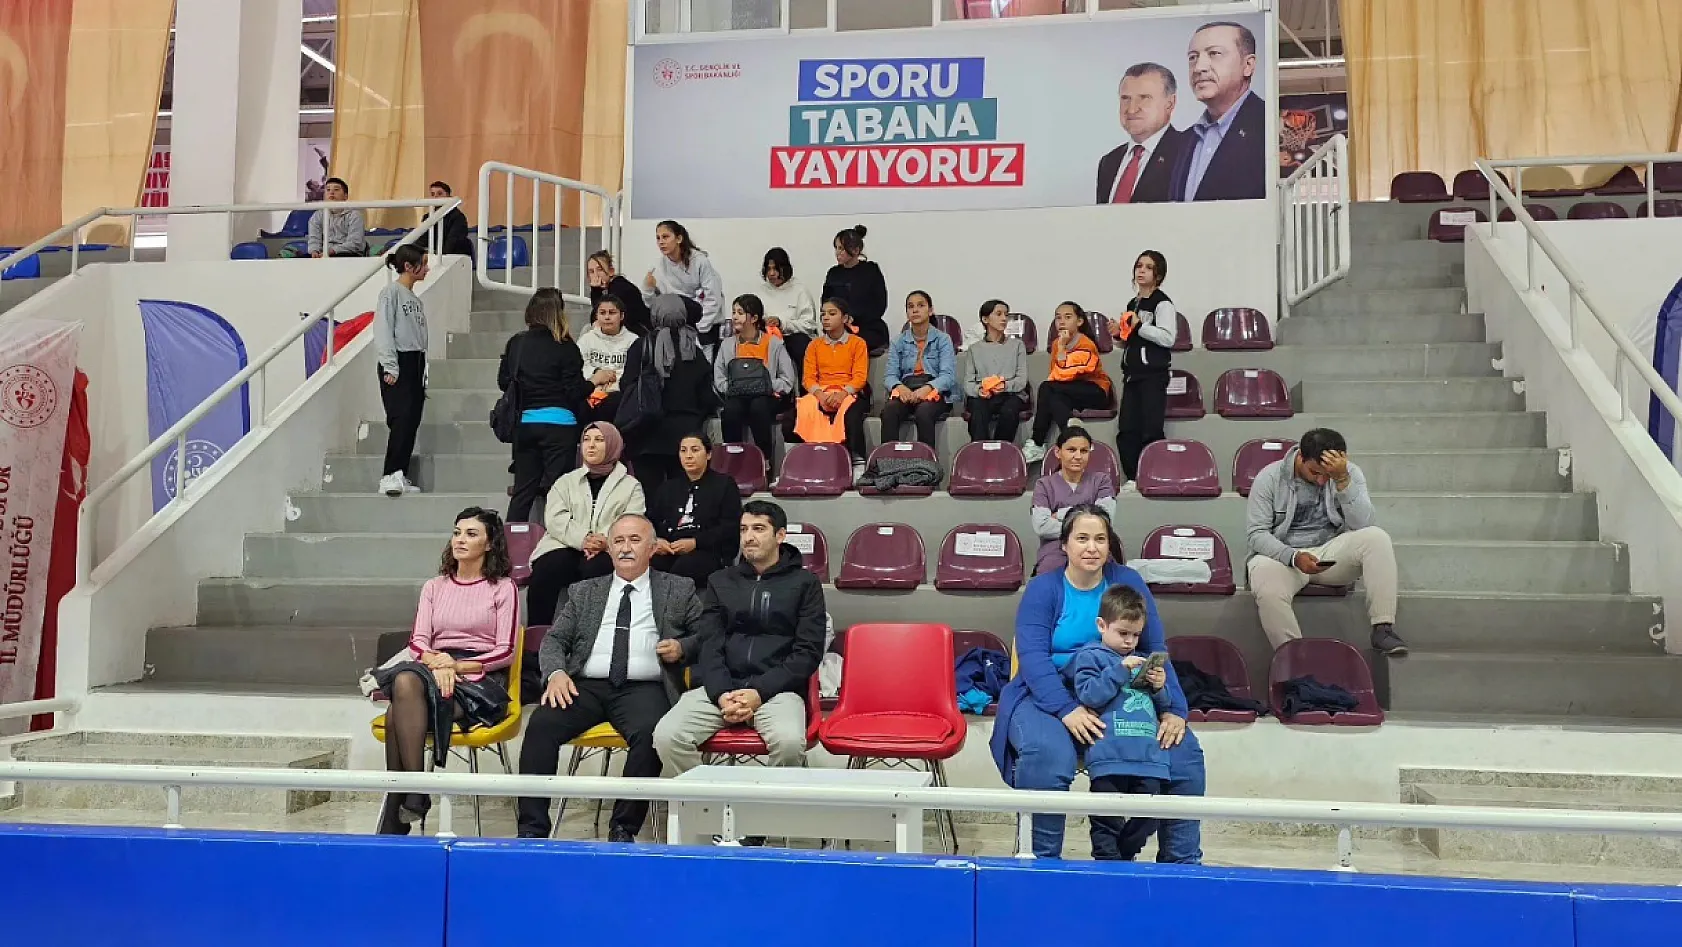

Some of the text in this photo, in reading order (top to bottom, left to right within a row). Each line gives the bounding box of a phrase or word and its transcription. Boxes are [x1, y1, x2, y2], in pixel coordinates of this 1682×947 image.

[813, 63, 959, 98] SPORU
[802, 102, 980, 144] TABANA
[776, 148, 1017, 185] YAYIYORUZ
[0, 515, 33, 642] MÜDÜRLÜĞÜ
